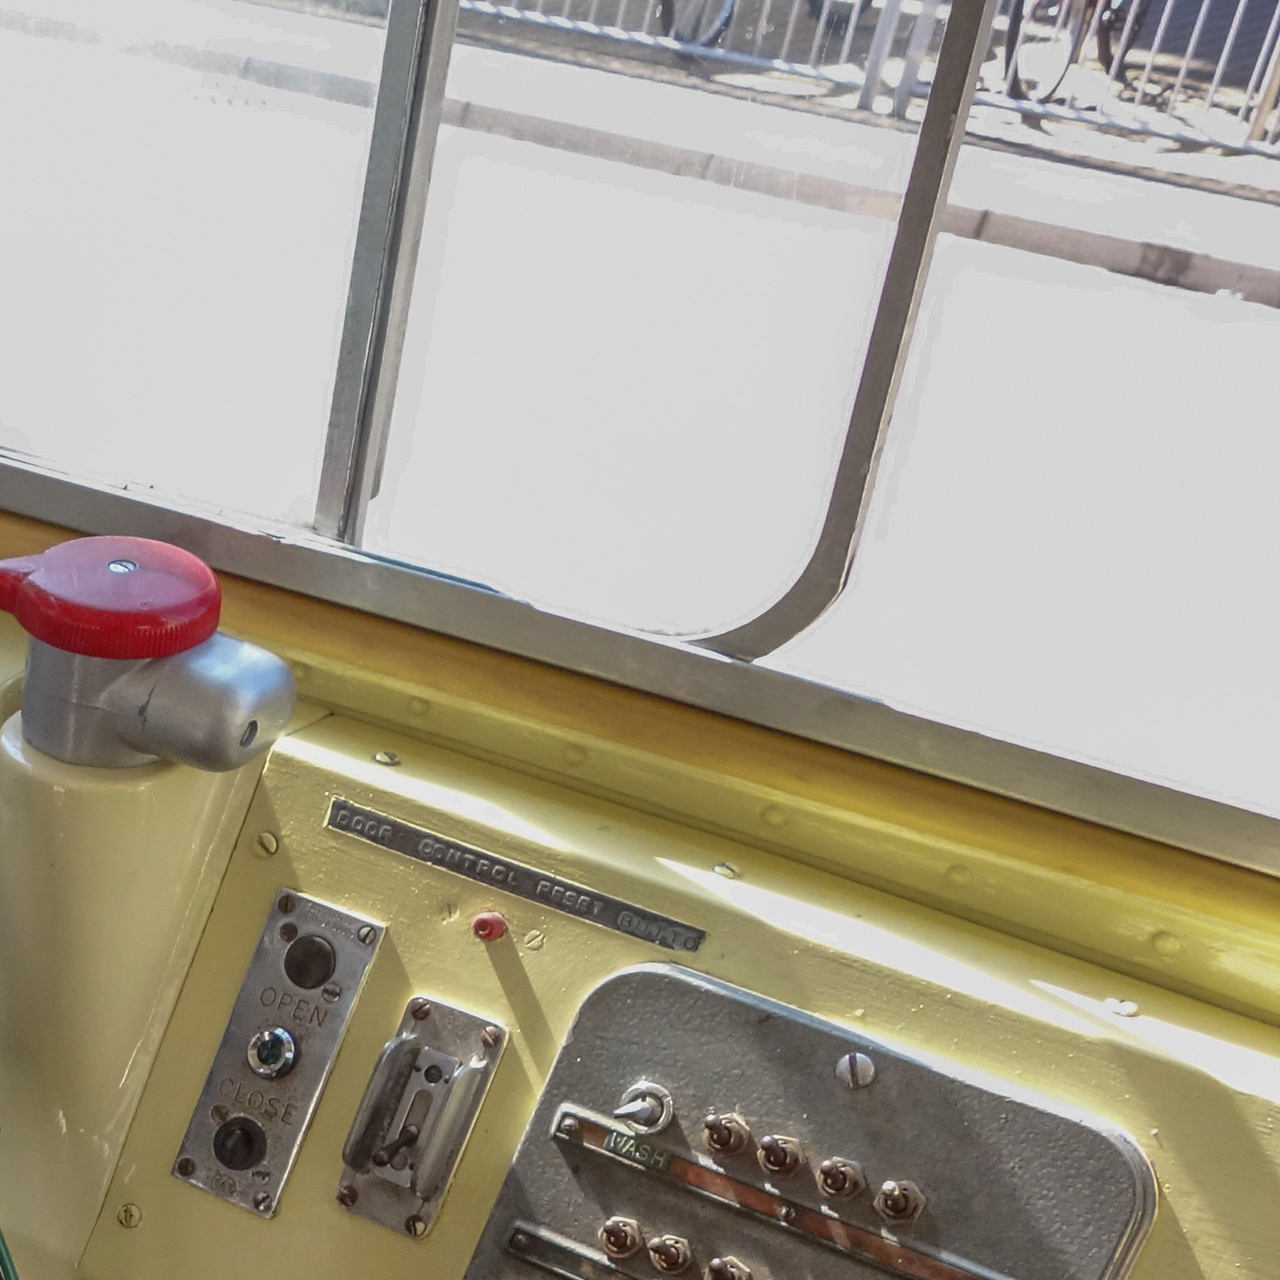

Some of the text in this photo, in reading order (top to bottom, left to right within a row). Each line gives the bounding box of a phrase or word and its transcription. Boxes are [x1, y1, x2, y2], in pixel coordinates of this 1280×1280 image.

[415, 834, 522, 887] CONTROL
[534, 878, 605, 917] RESET
[255, 983, 331, 1030] OPEN
[213, 1074, 302, 1128] CLOSE
[605, 1130, 668, 1169] WASH
